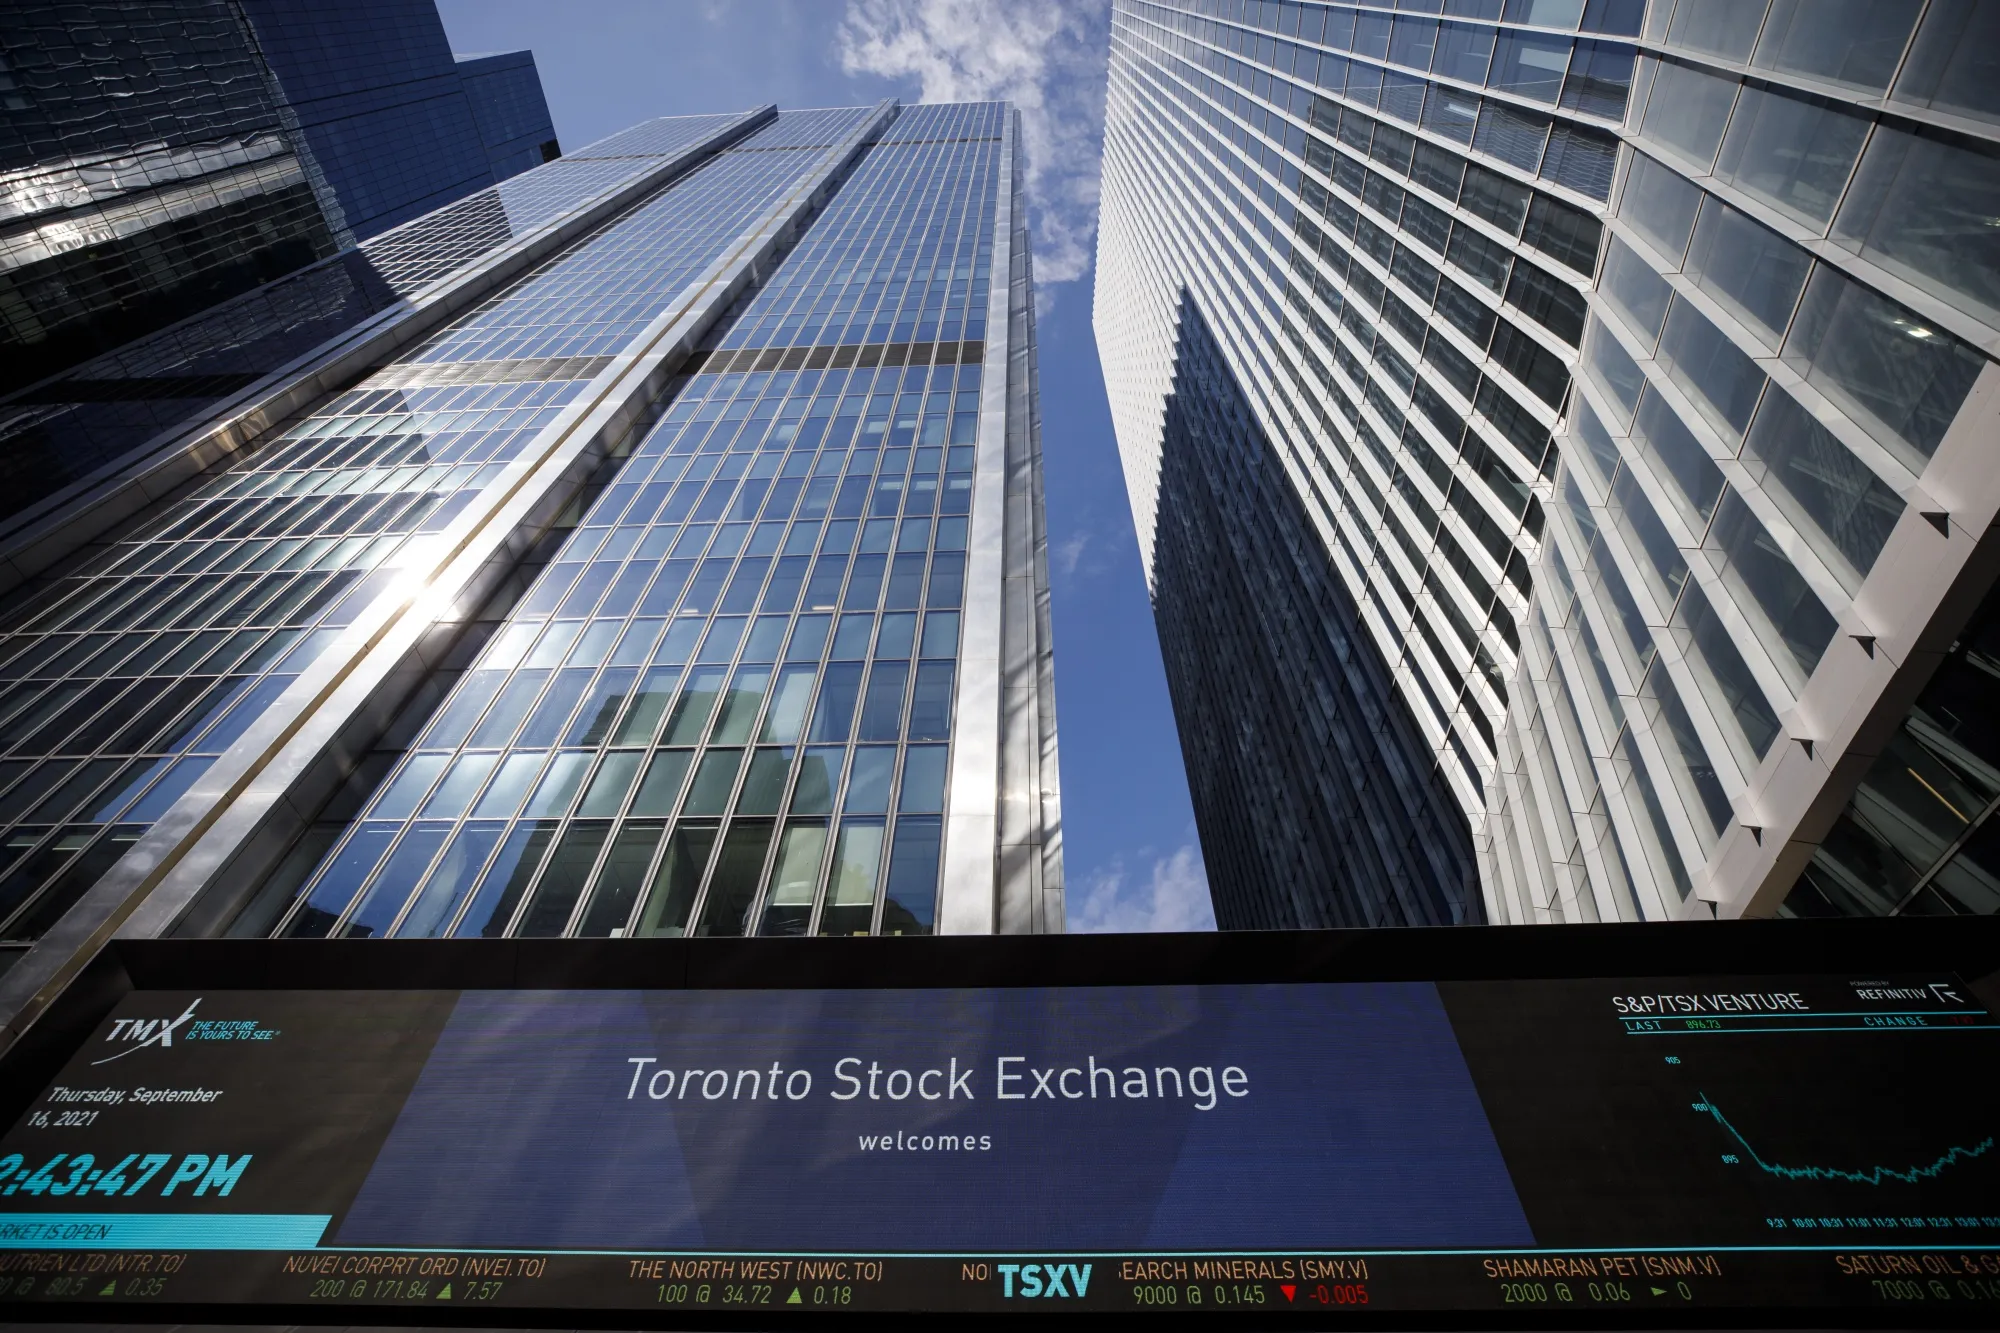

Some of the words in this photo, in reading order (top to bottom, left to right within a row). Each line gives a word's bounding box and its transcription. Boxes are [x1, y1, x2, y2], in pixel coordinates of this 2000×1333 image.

[1613, 994, 1707, 1014] S&P/TSX
[1702, 992, 1809, 1012] VENTURE
[1856, 988, 1927, 1000] REFINITIV
[192, 1020, 215, 1030] THE
[213, 1020, 259, 1030] FUTURE
[1625, 1020, 1662, 1031] LAST
[1685, 1019, 1721, 1029] 896.73
[1863, 1016, 1929, 1026] CHANGE
[185, 1030, 199, 1040] IS
[199, 1030, 235, 1040] YOURS
[236, 1030, 251, 1040] TO
[1665, 1056, 1681, 1064] 905
[626, 1057, 813, 1100] Toronto
[829, 1056, 975, 1100] Stock
[997, 1056, 1250, 1111] Exchange
[47, 1086, 127, 1105] Thursday,
[129, 1087, 223, 1105] September
[1691, 1103, 1708, 1111] 900
[27, 1110, 49, 1129] 16,
[53, 1110, 100, 1126] 2021
[858, 1130, 992, 1151] welcomes
[1721, 1154, 1739, 1163] 895
[160, 1154, 253, 1197] PM
[43, 1223, 65, 1240] IS
[62, 1223, 113, 1240] OPEN
[1766, 1217, 1787, 1228] 9:31
[1792, 1217, 1818, 1228] 10:01
[1818, 1217, 1844, 1228] 10:31
[1845, 1217, 1872, 1228] 11:01
[1872, 1217, 1899, 1228] 11:31
[1900, 1216, 1926, 1228] 12:01
[1927, 1216, 1953, 1228] 12:31
[0, 1253, 65, 1273] UTRIEN
[67, 1253, 107, 1273] LTD
[282, 1255, 338, 1274] NUVEI
[342, 1255, 418, 1275] CORPRT
[419, 1256, 459, 1276] ORD
[629, 1260, 666, 1279] THE
[669, 1260, 735, 1279] NORTH
[740, 1261, 793, 1280] WEST
[796, 1260, 883, 1282] (NWC.TO)
[1118, 1260, 1188, 1280] EARCH
[1194, 1260, 1295, 1280] MINERALS
[1299, 1259, 1369, 1281] (SMY.V)
[1483, 1257, 1599, 1278] SHAMARAN
[1600, 1256, 1639, 1276] PET
[1835, 1254, 1924, 1276] SATURN
[1921, 1254, 1962, 1275] OIL
[1960, 1254, 1982, 1275] &
[125, 1277, 168, 1297] 0.35
[309, 1279, 345, 1298] 200
[349, 1279, 367, 1298] @
[373, 1279, 430, 1299] 171.84
[463, 1281, 503, 1300] 7.57
[997, 1263, 1093, 1298] TSXV
[1872, 1279, 1925, 1300] 7000
[1928, 1279, 1951, 1300] @
[657, 1284, 687, 1304] 100
[695, 1284, 711, 1303] @
[722, 1284, 772, 1304] 34.72
[813, 1285, 852, 1305] 0.18
[1133, 1285, 1177, 1305] 9000
[1187, 1285, 1201, 1304] @
[1214, 1284, 1265, 1304] 0.145
[1308, 1284, 1369, 1305] -0.005
[1500, 1282, 1548, 1302] 2000
[1554, 1282, 1573, 1302] @
[1588, 1281, 1631, 1302] 0.06
[1676, 1281, 1692, 1301] 0
